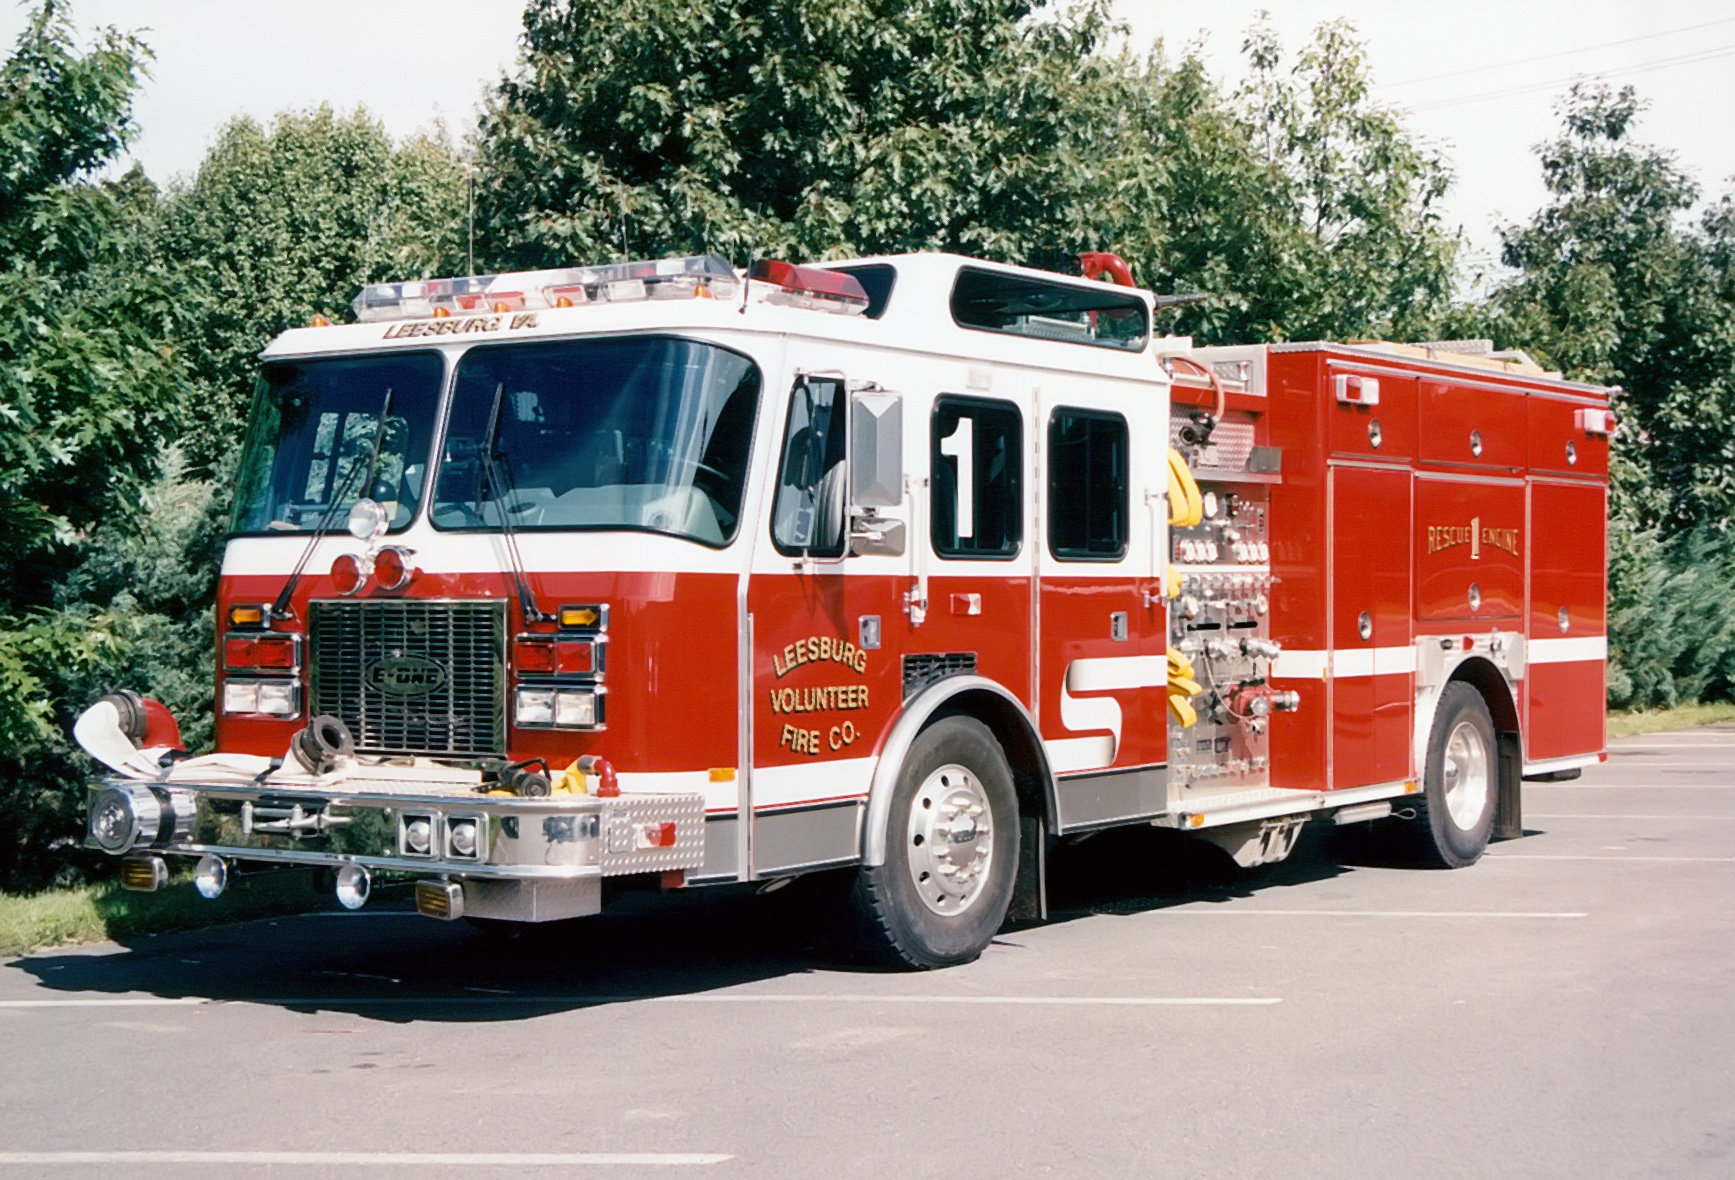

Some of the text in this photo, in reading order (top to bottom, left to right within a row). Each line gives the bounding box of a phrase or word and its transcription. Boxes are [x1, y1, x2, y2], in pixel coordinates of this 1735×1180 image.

[382, 315, 502, 340] LEESBURG
[940, 416, 973, 538] 1
[1428, 516, 1519, 560] RESCUE 1 ENGINE
[773, 636, 867, 679] LEESBURG
[372, 667, 440, 684] E-ONE
[769, 685, 869, 714] VOLUNTEER
[780, 720, 861, 755] FIRE CO.
